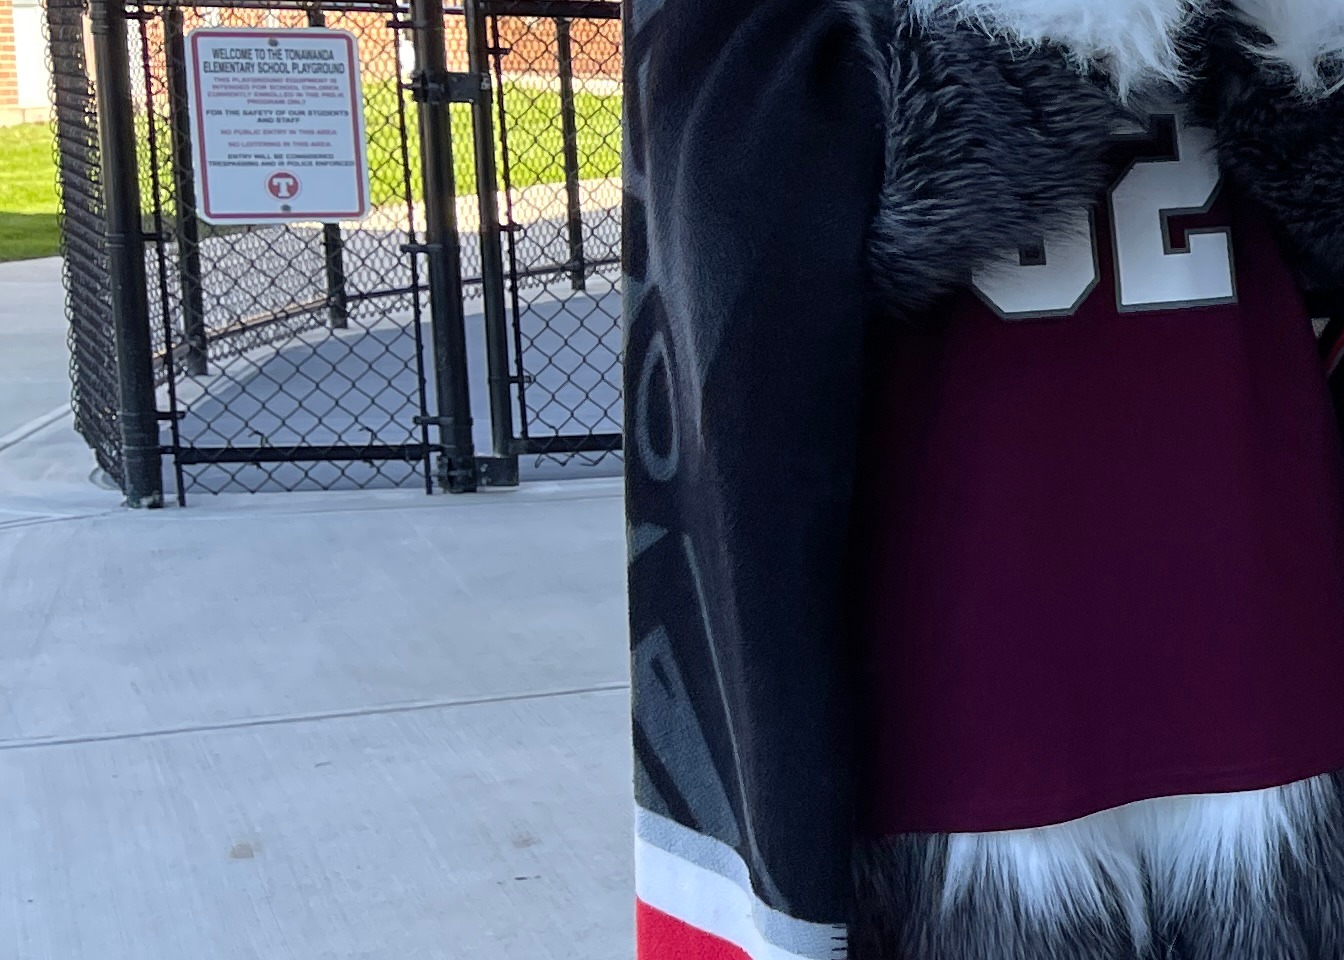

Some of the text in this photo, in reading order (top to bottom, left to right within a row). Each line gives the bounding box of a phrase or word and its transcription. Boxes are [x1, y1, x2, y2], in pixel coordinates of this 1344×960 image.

[211, 48, 334, 61] WELCOME TO THE TONAWANDA
[203, 61, 345, 75] ELEMENTARY SCHOOL PLAYGROUND
[272, 177, 294, 197] T
